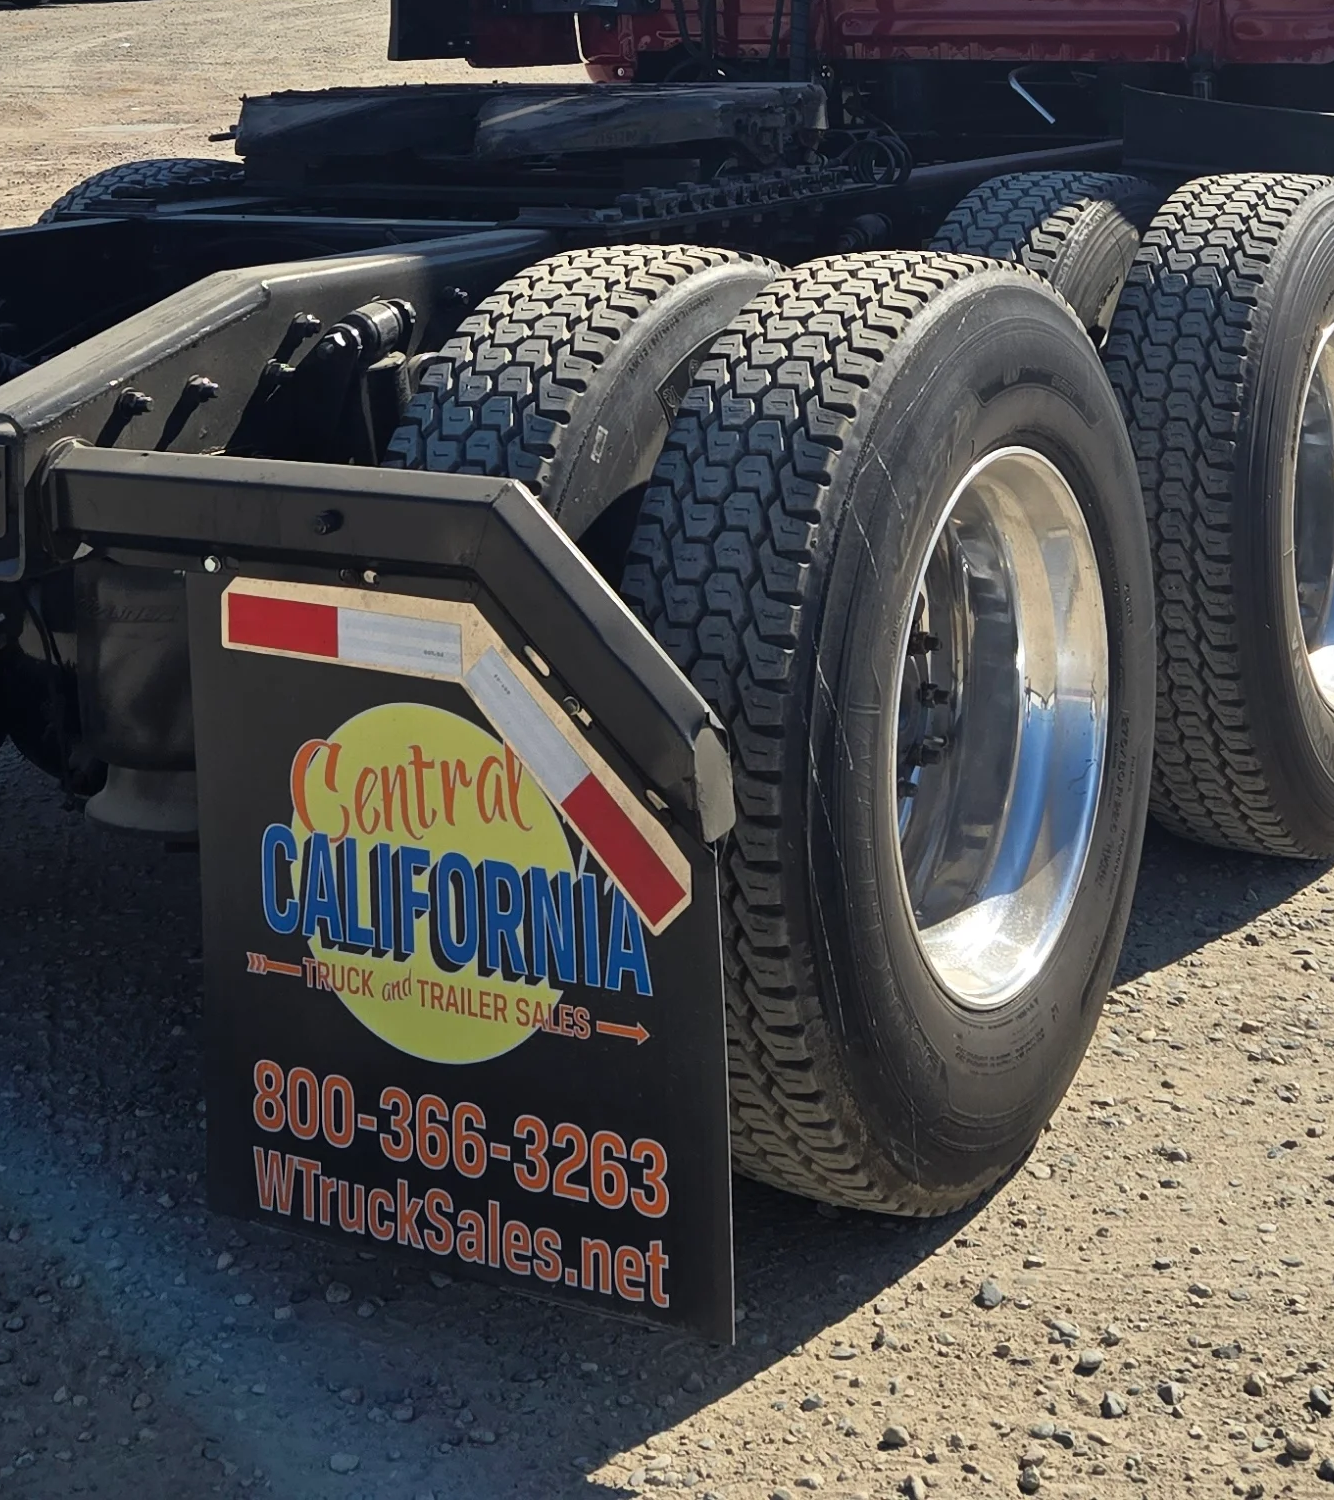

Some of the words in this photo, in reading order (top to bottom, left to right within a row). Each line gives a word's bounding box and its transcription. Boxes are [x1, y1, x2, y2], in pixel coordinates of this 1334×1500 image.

[291, 738, 534, 843] Central
[262, 824, 654, 997] CALIFORNIA
[302, 957, 375, 998] TRUCK
[381, 969, 413, 1003] and
[416, 978, 508, 1023] TRAILER
[515, 997, 591, 1041] SALES
[253, 1059, 670, 1219] 800-366-3263
[253, 1146, 670, 1308] WTruckSales.net
